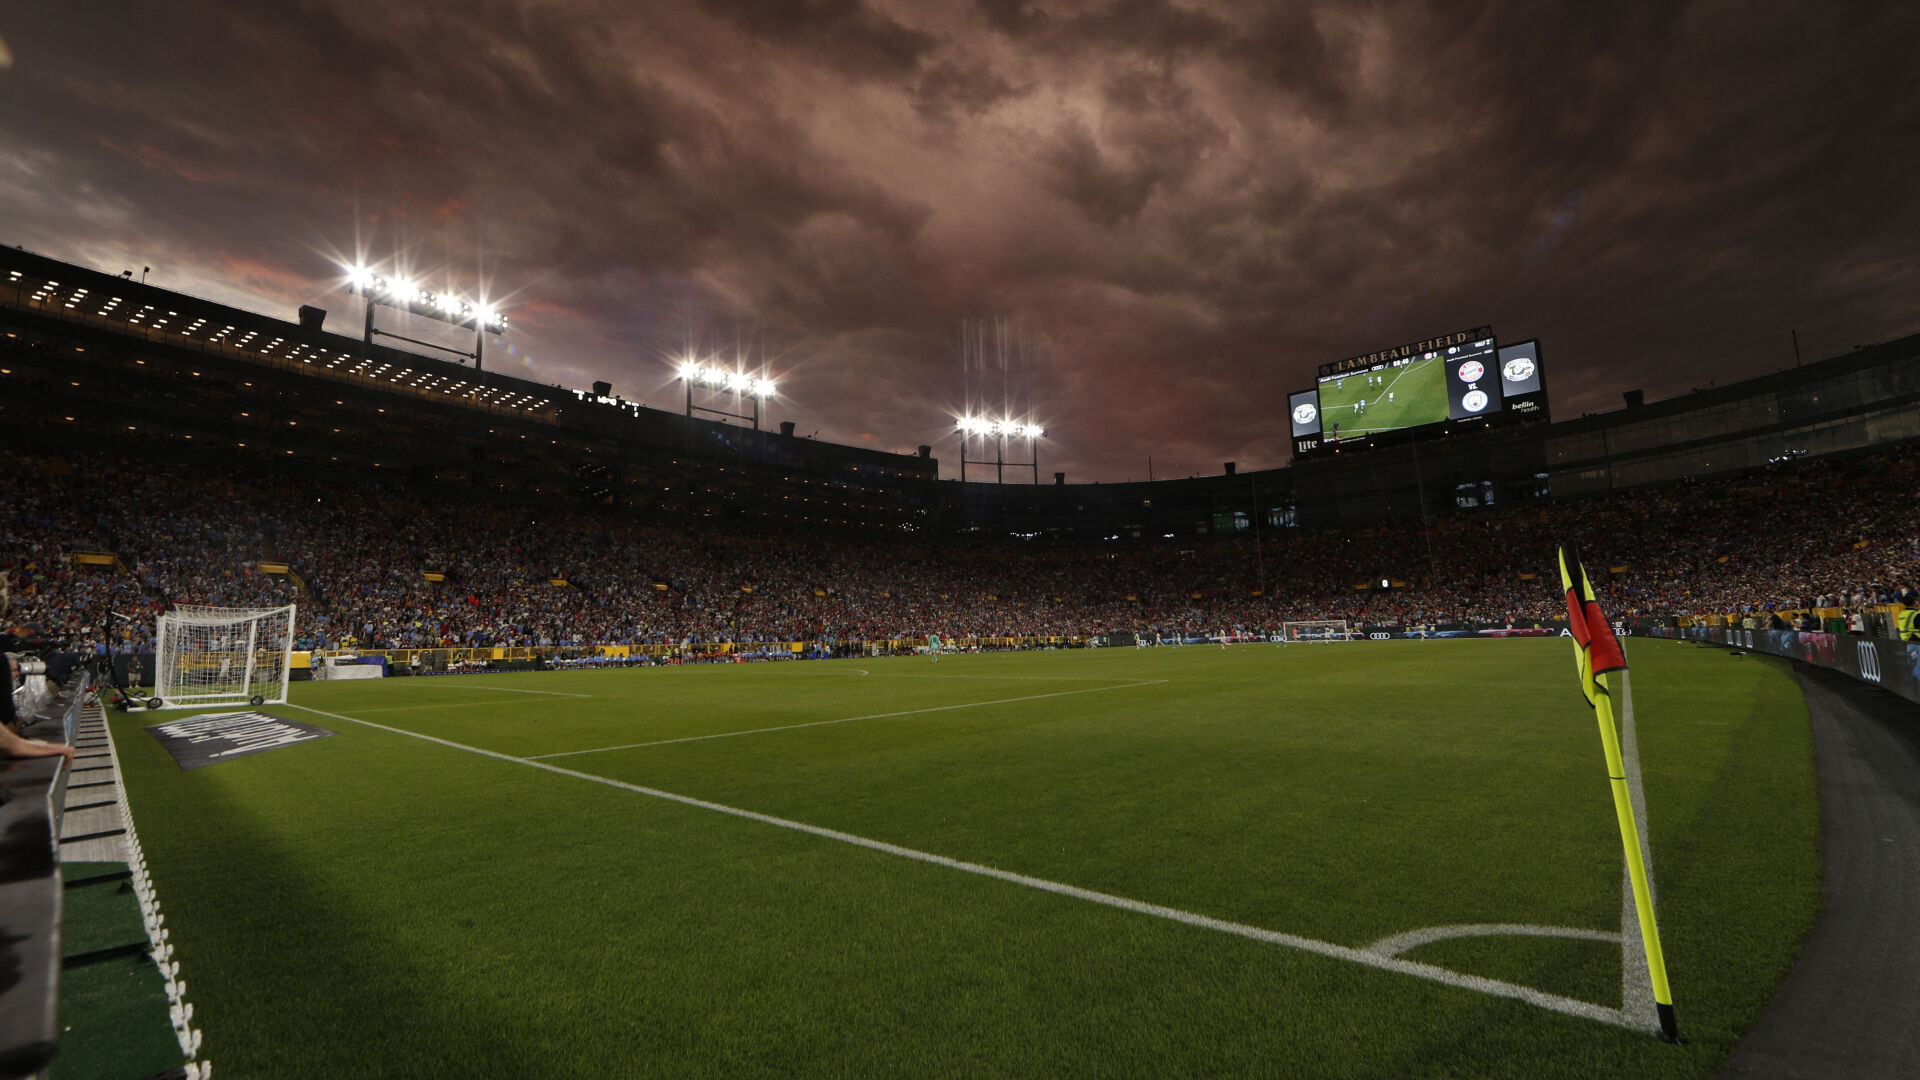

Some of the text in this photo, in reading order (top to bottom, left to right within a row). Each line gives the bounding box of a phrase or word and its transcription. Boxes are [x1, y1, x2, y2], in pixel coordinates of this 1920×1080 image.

[1337, 333, 1467, 371] LAMBEAU FIELD
[1512, 401, 1534, 410] bellin
[1298, 439, 1318, 453] Lite
